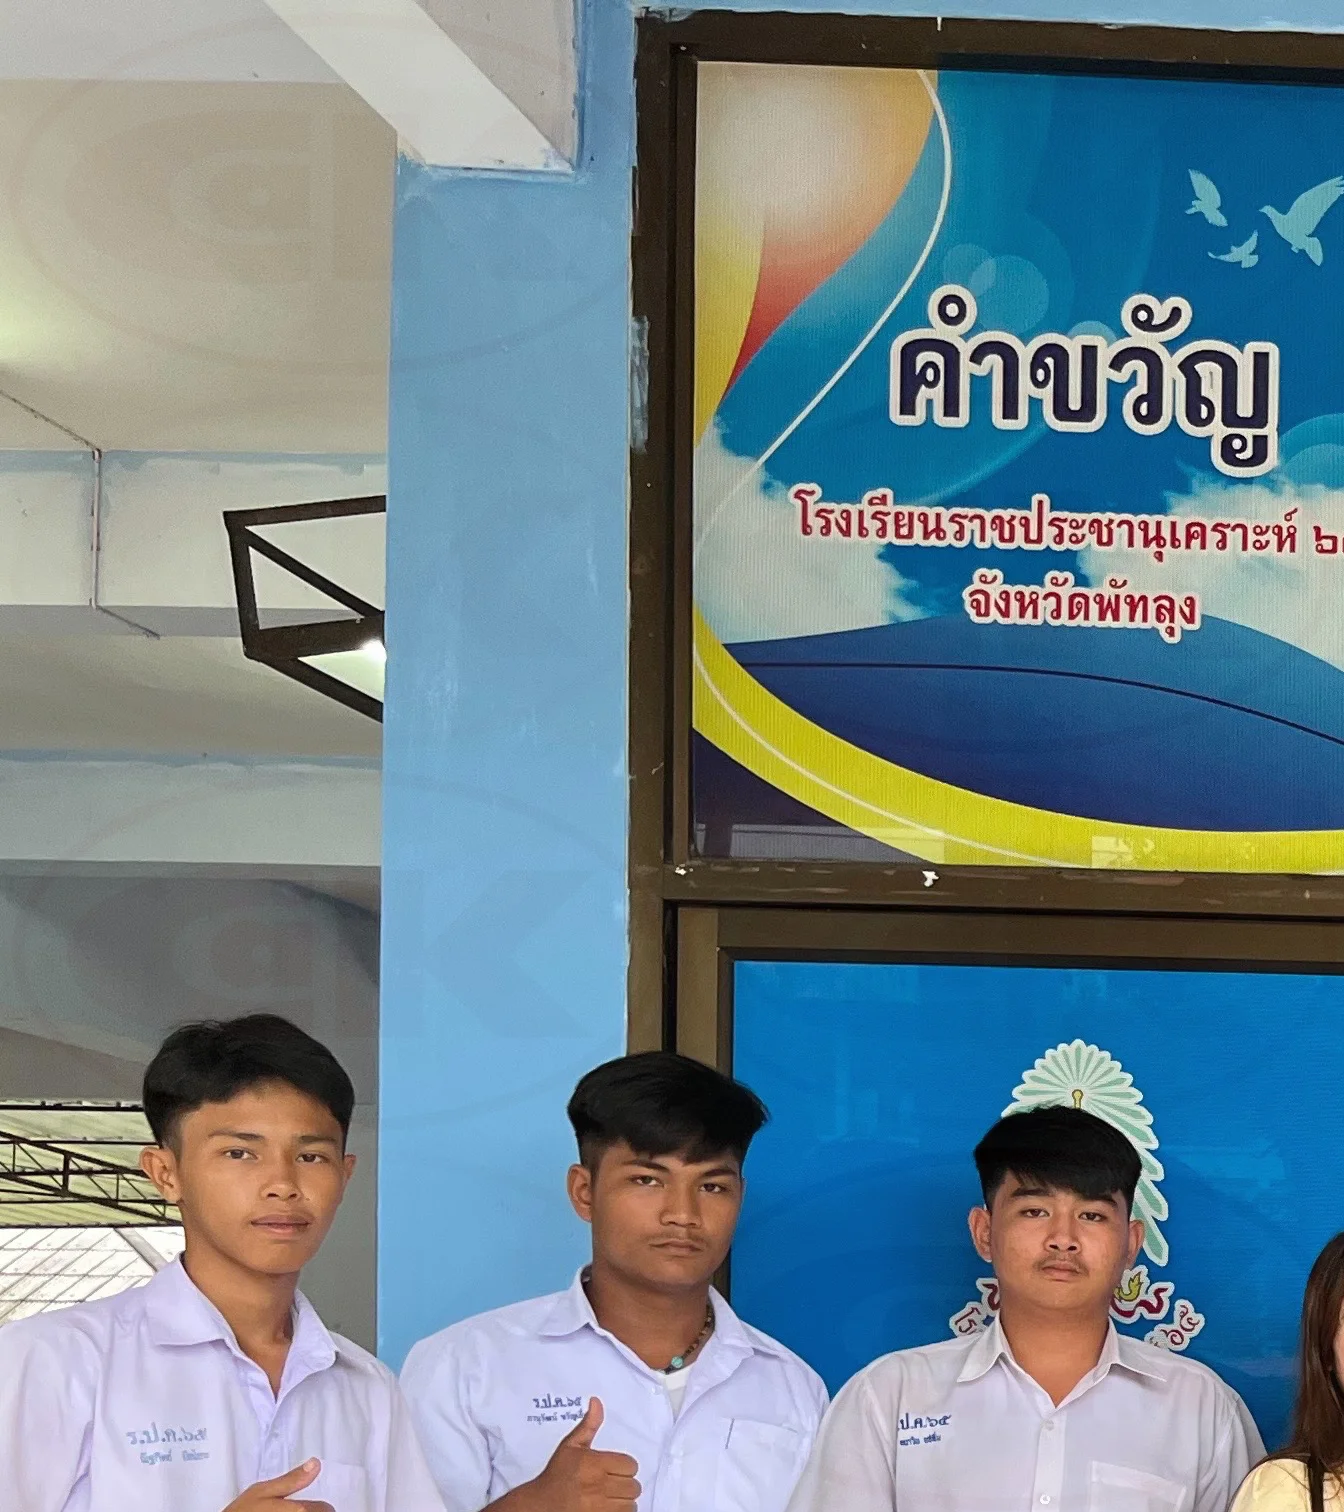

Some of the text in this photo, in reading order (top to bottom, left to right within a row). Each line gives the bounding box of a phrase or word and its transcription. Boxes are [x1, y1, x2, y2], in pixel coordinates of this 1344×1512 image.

[896, 293, 1269, 468] คำขวัญ
[796, 490, 1296, 560] โรงเรียนราชประชานุเคราะห์
[971, 576, 1196, 635] จังหวัดพัทลุง
